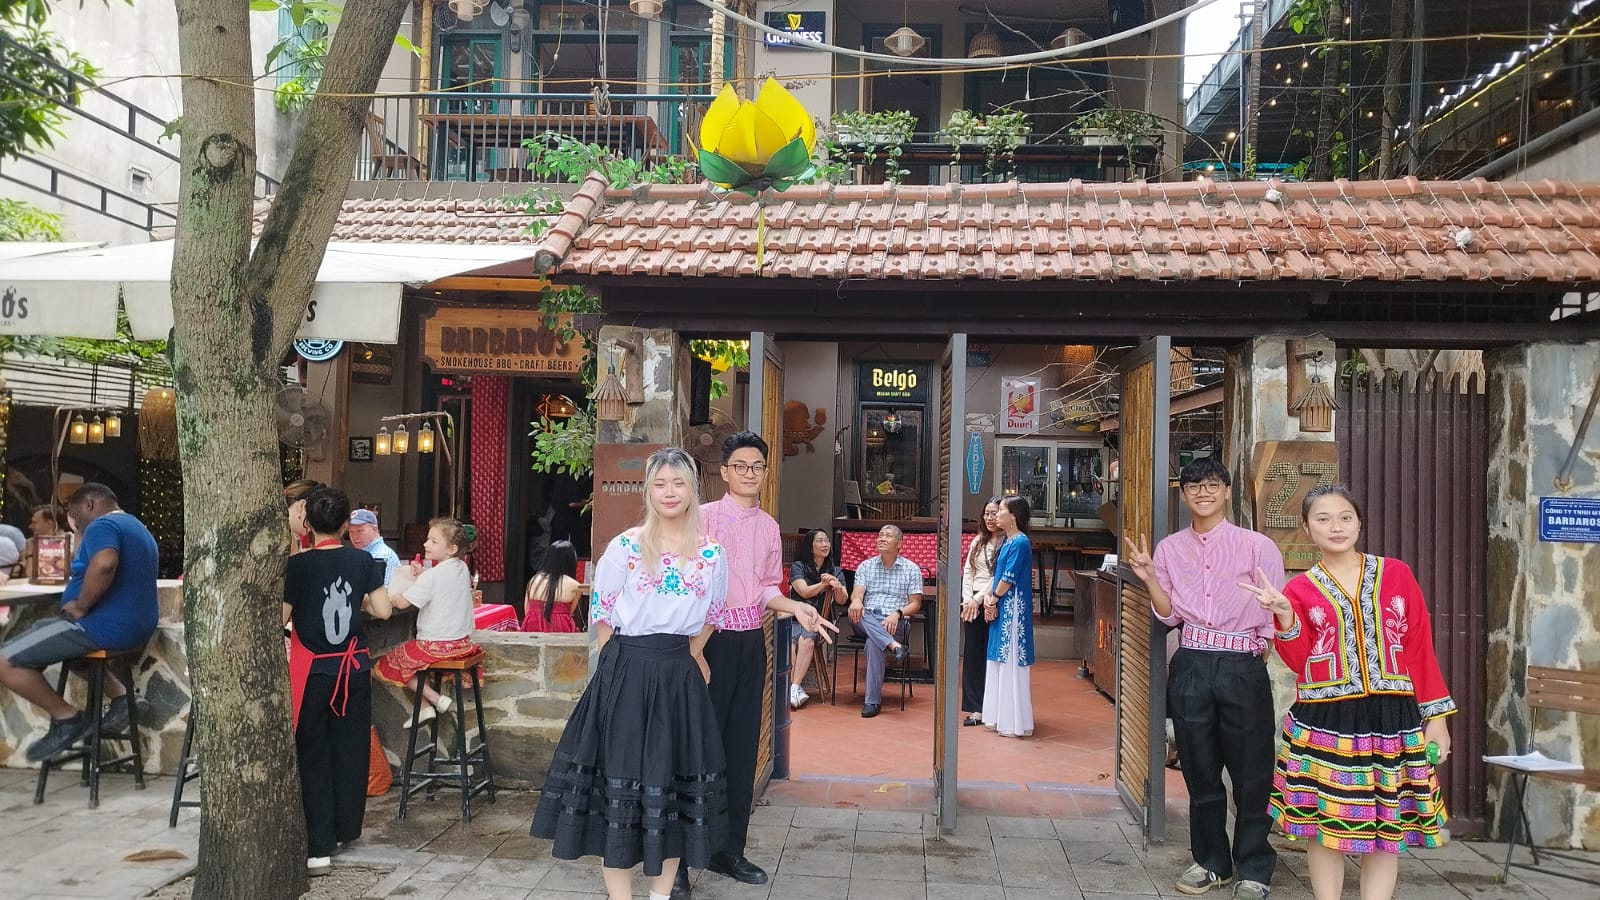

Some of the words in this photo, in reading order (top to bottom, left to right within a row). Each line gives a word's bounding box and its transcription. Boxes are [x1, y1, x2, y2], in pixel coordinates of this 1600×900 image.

[440, 357, 493, 368] SMOKEHOUSE
[496, 358, 512, 369] BBQ
[519, 359, 544, 370] CRAFT
[547, 360, 573, 371] BEERS
[1008, 419, 1033, 428] Duvel
